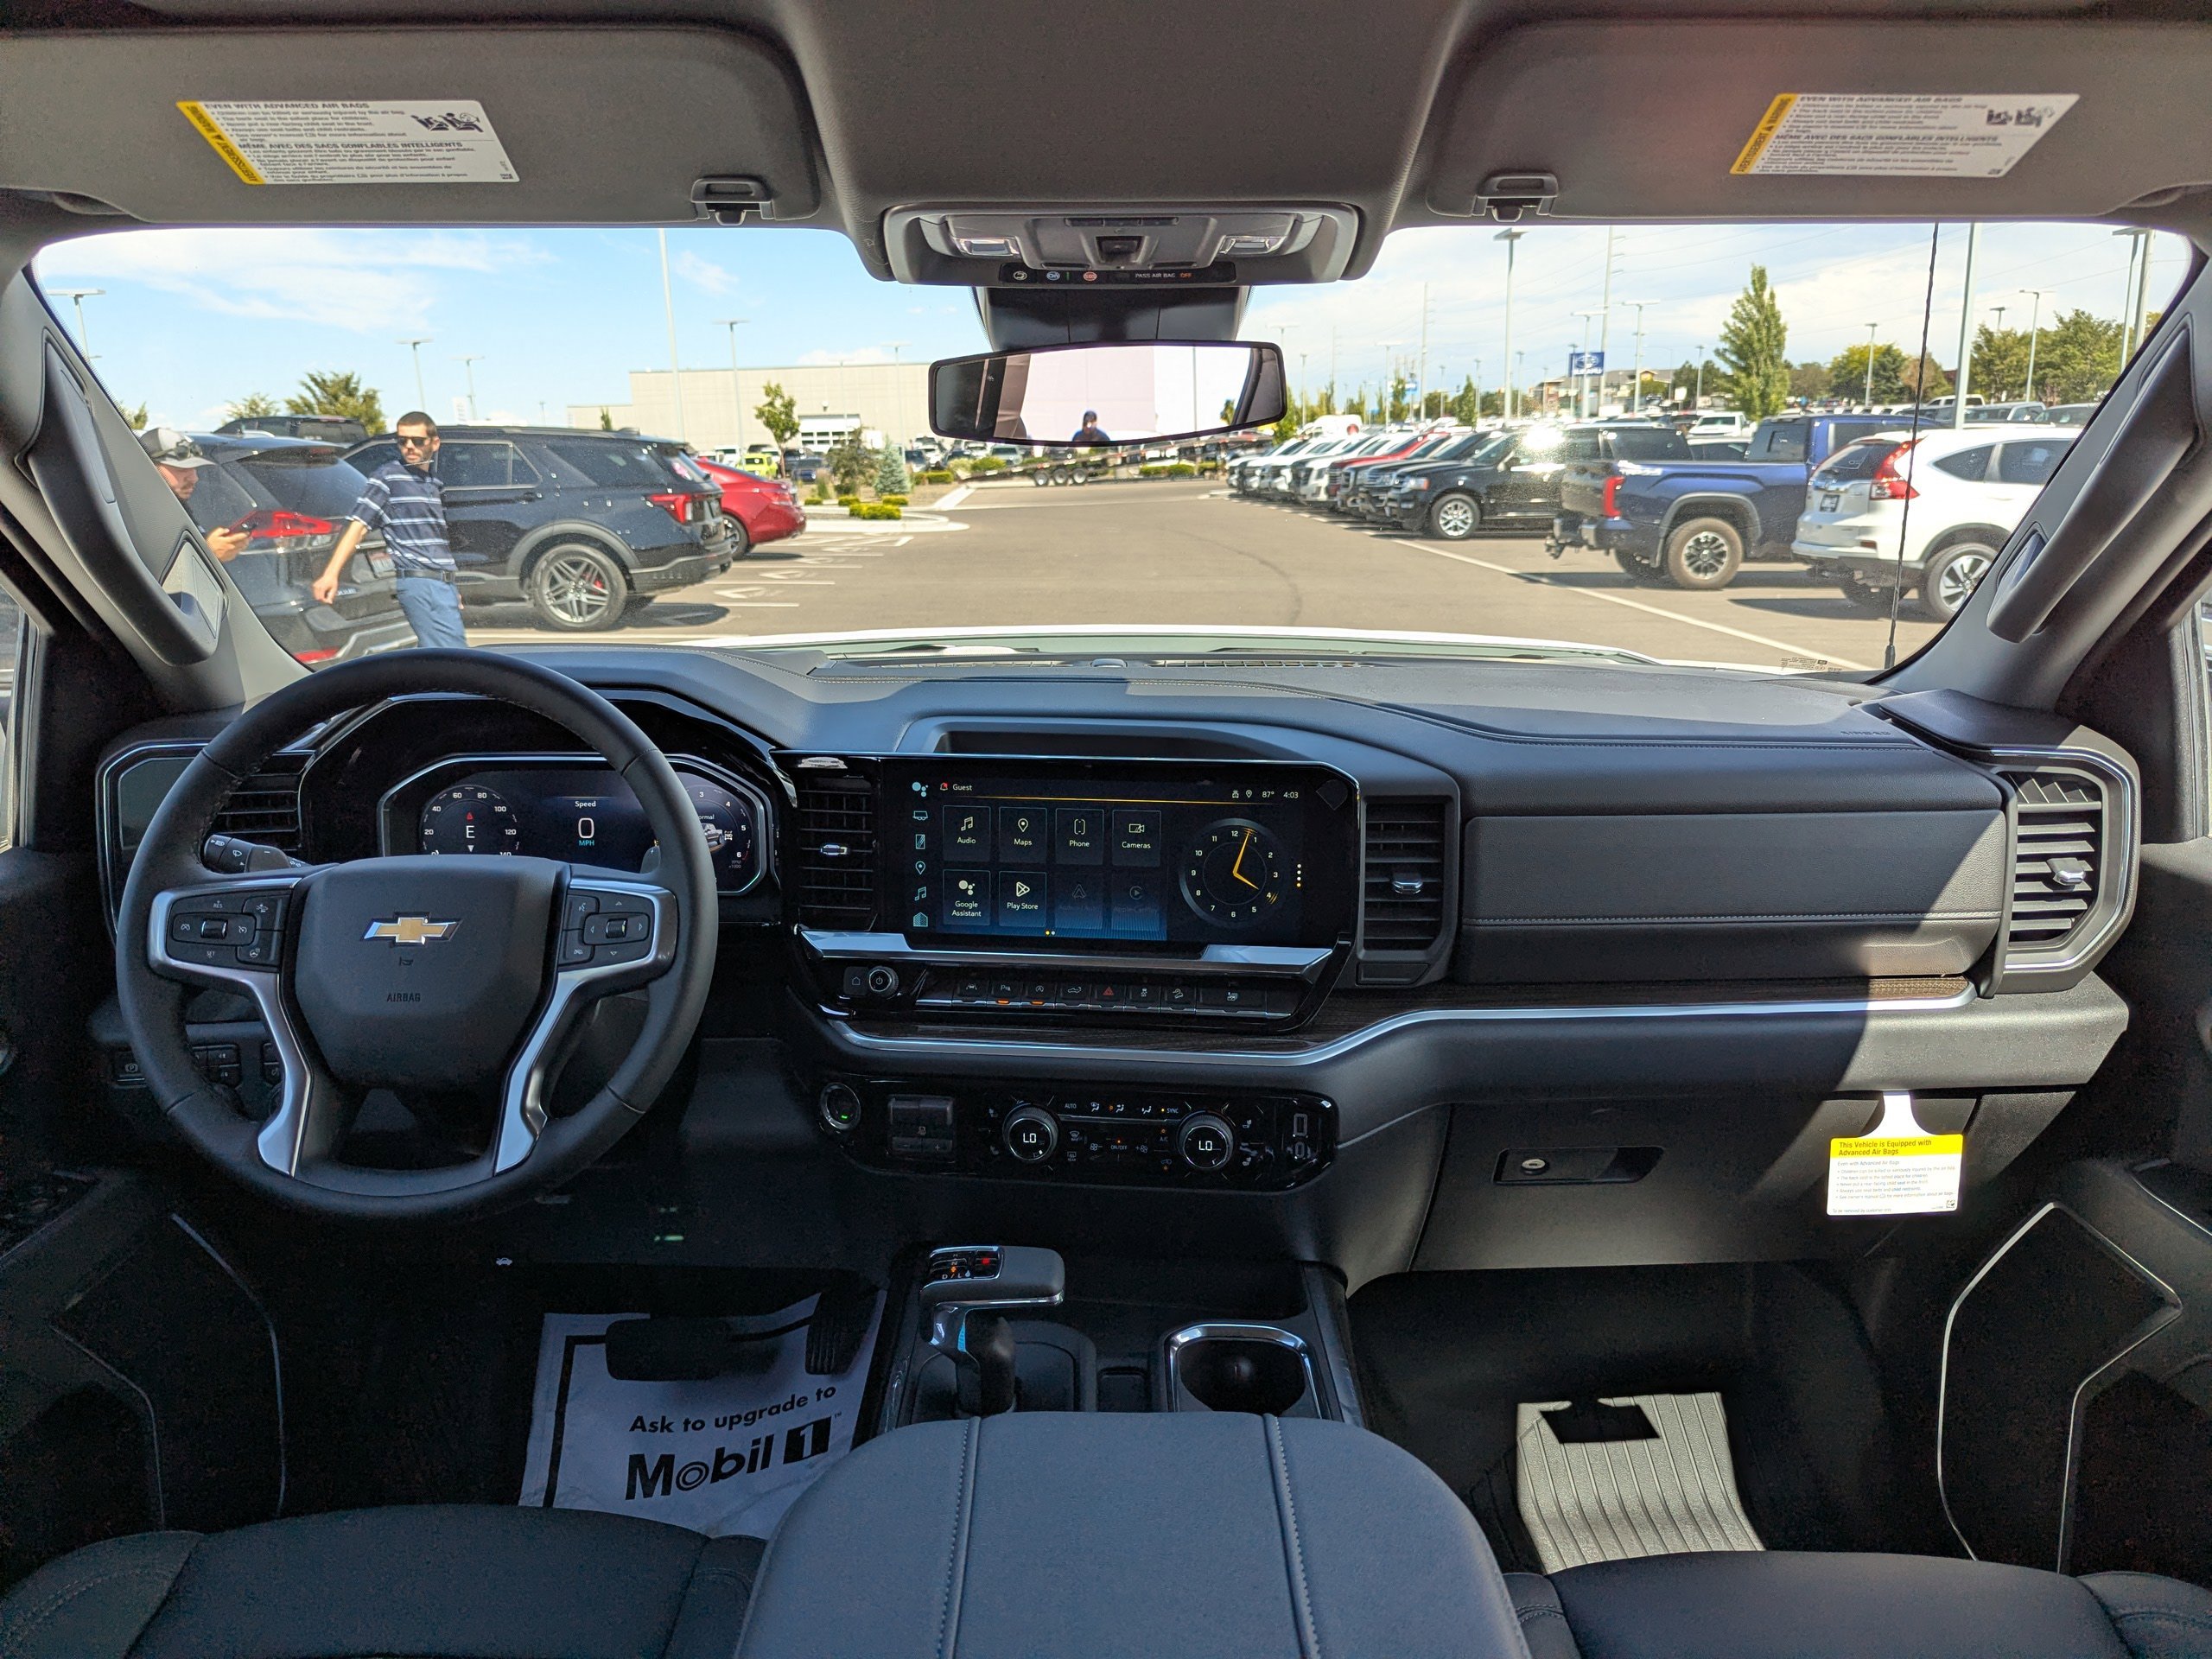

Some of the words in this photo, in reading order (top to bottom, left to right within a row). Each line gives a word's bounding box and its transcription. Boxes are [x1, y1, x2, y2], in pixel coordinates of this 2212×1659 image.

[575, 800, 596, 809] Speed
[466, 825, 475, 838] E
[578, 817, 594, 838] 0
[1014, 838, 1033, 847] Maps
[955, 900, 978, 909] Google
[1007, 902, 1020, 911] Play
[386, 992, 421, 1002] AIRBAG
[1023, 1133, 1037, 1143] LO
[1198, 1141, 1212, 1151] LO
[1887, 1140, 1916, 1148] Equipped
[629, 1415, 675, 1433] Ask
[683, 1417, 706, 1433] to
[715, 1394, 808, 1431] upgrade
[816, 1387, 836, 1402] to
[625, 1433, 775, 1501] Mobil
